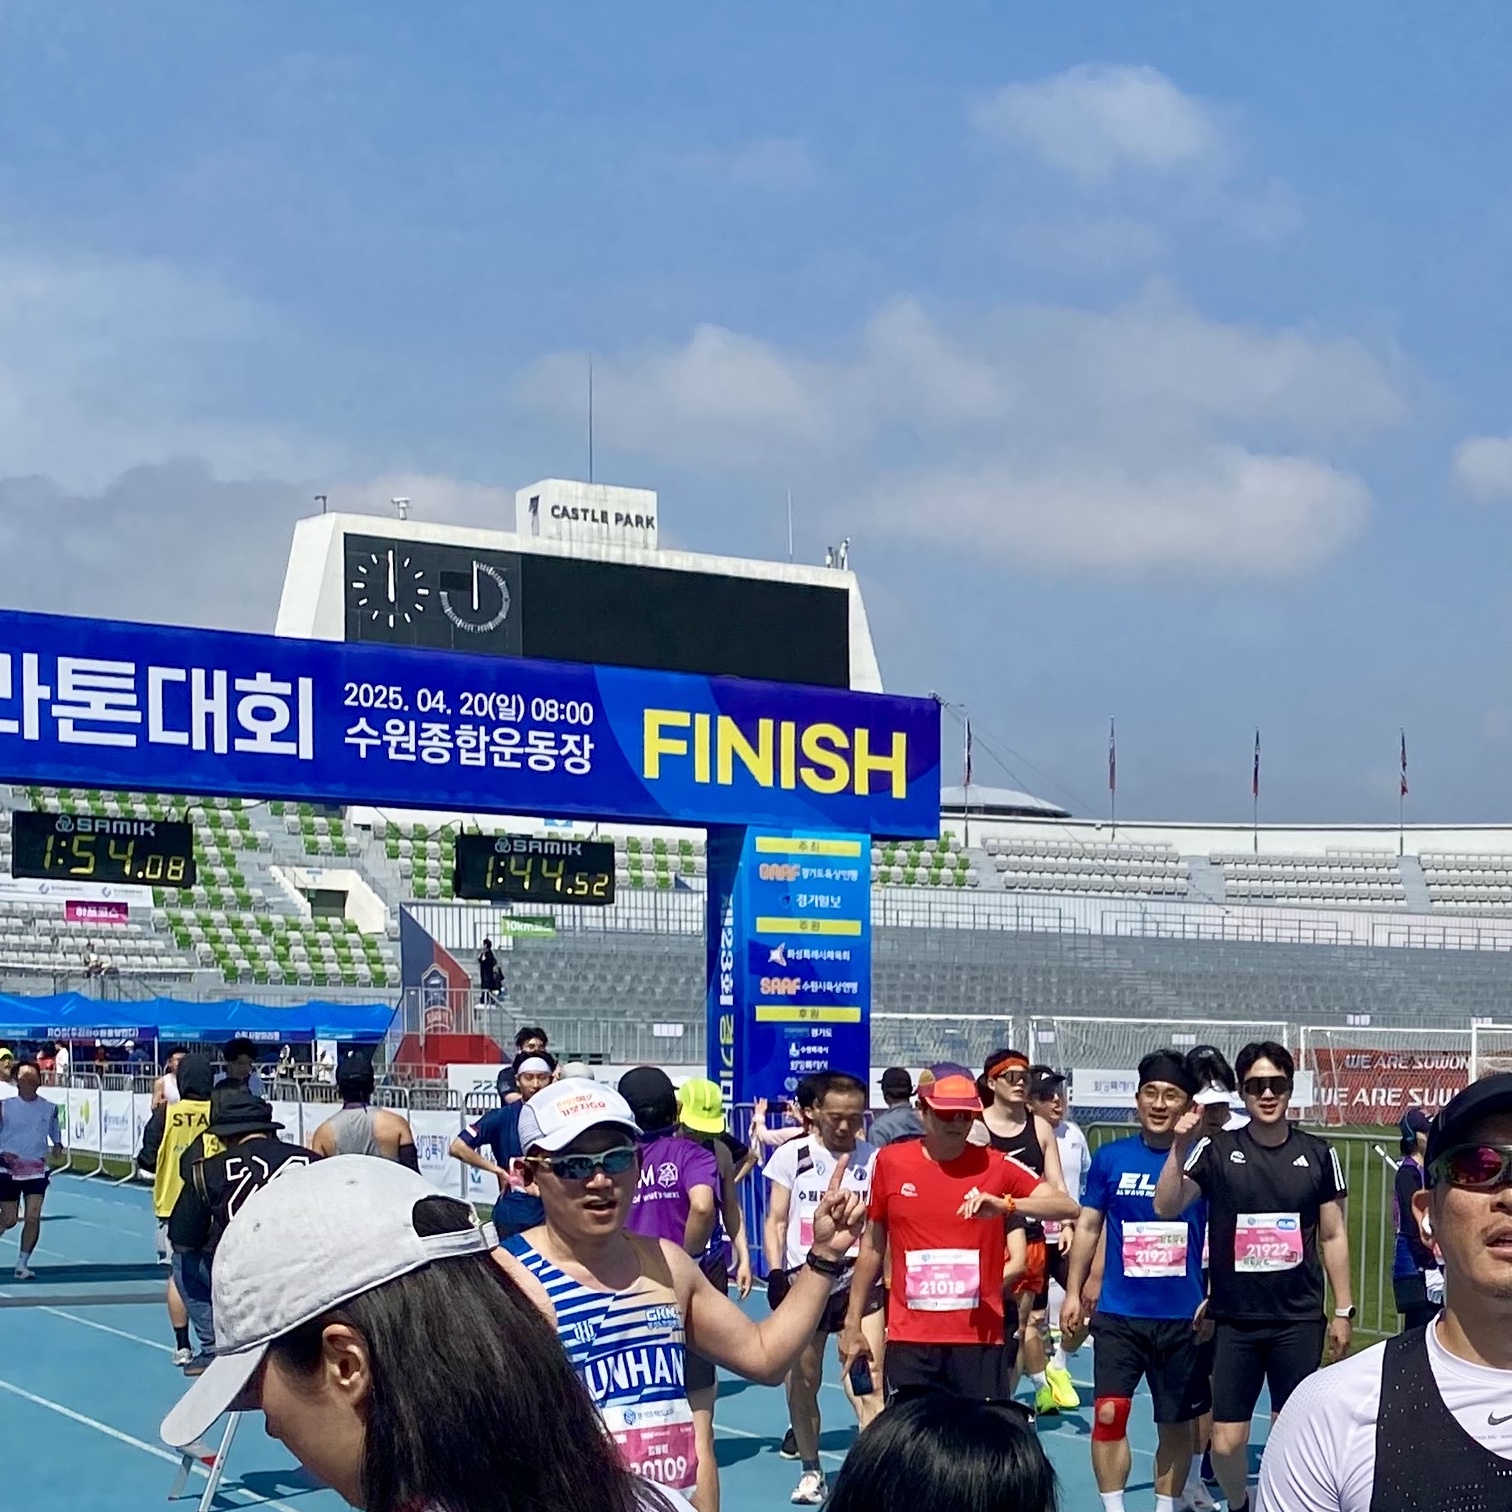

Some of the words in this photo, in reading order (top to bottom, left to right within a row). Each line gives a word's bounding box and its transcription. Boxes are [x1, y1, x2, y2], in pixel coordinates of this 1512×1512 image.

[551, 504, 609, 525] CASTLE
[615, 512, 656, 530] PARK
[343, 682, 410, 712] 2025.
[416, 688, 452, 715] 04.
[459, 691, 525, 723] 20(일)
[531, 697, 595, 726] 08:00
[344, 717, 595, 775] 수원종합운동장
[643, 708, 907, 799] FINISH
[76, 816, 156, 837] SAMIK
[511, 839, 582, 856] SAMIK
[1373, 1055, 1408, 1069] ARE
[1351, 1087, 1403, 1107] ARE
[172, 1111, 210, 1128] STA
[1134, 1248, 1174, 1263] 21921
[1246, 1242, 1290, 1258] 21922
[919, 1280, 966, 1296] 21018
